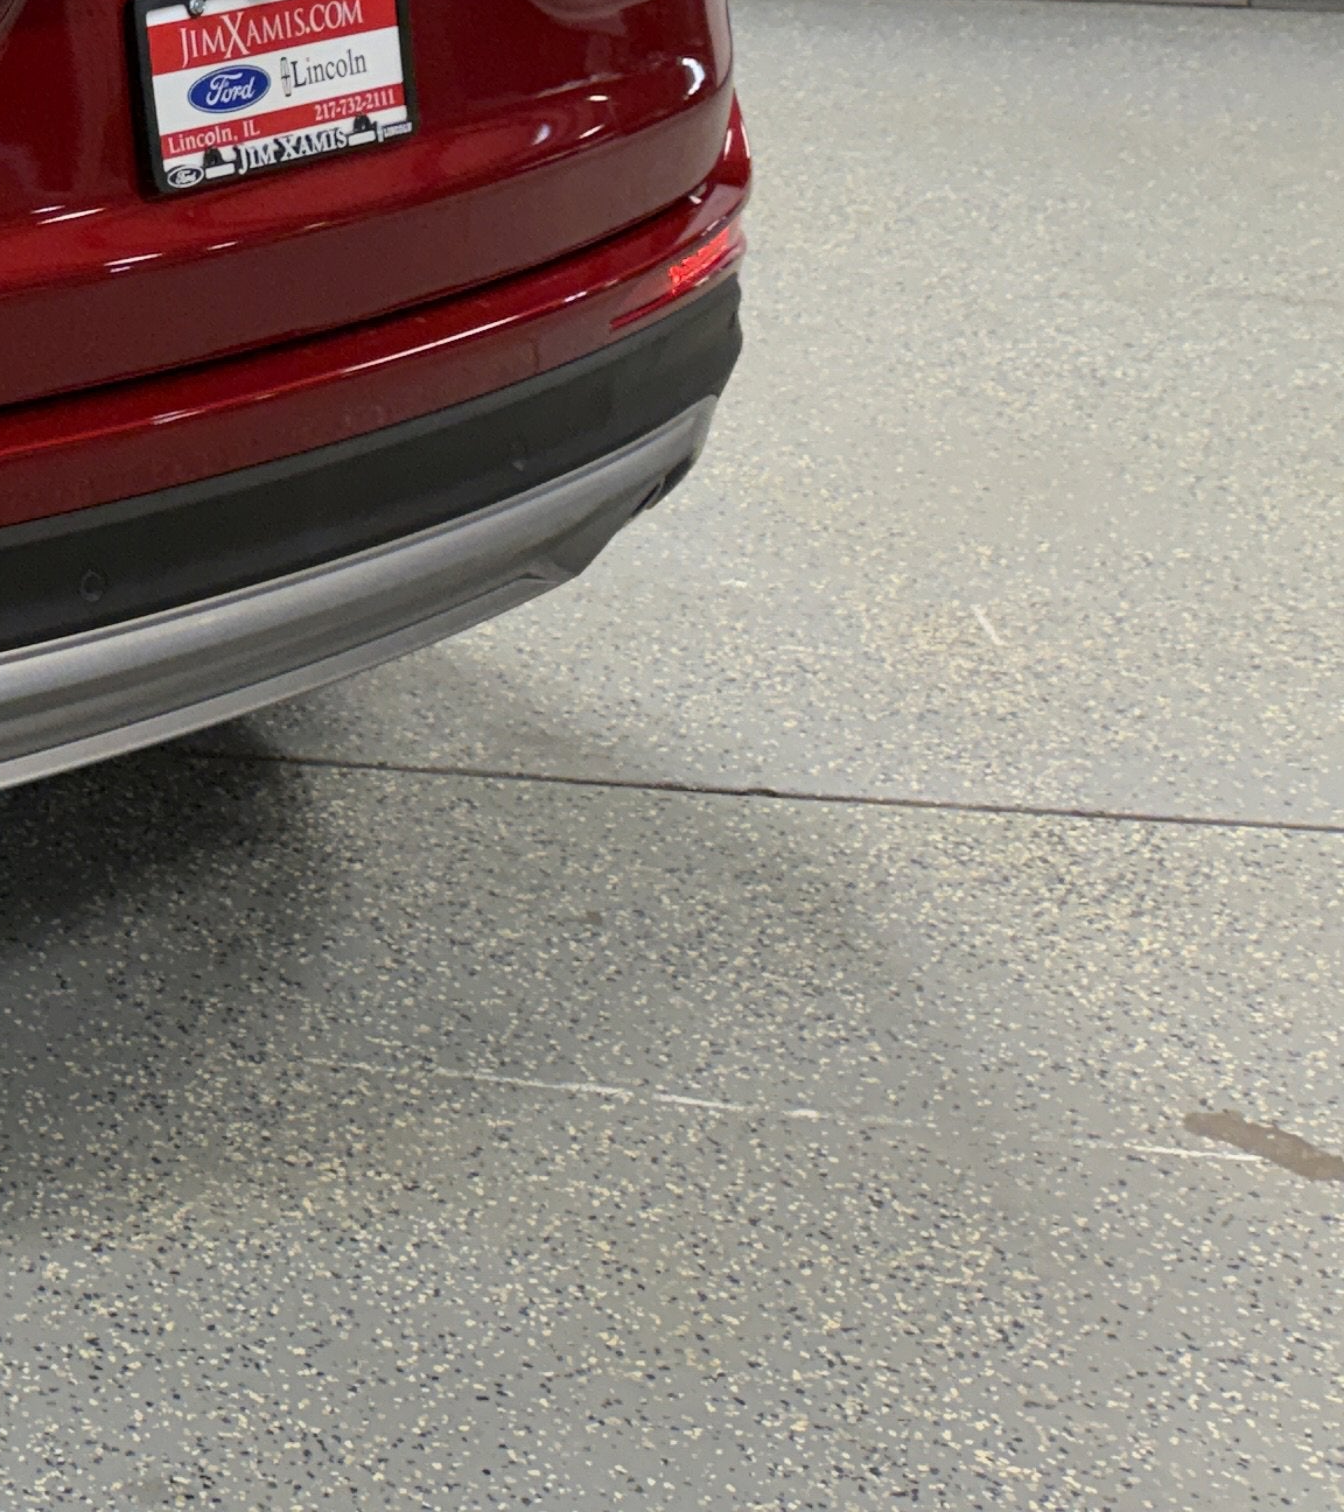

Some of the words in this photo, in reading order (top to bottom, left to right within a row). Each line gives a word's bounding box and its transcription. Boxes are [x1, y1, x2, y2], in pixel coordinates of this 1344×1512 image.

[290, 48, 368, 89] Lincoln
[314, 88, 396, 122] 217-732-2111
[167, 124, 238, 155] Lincoln,
[242, 119, 261, 137] IL
[237, 144, 278, 175] JIM
[279, 128, 349, 163] XAMIS
